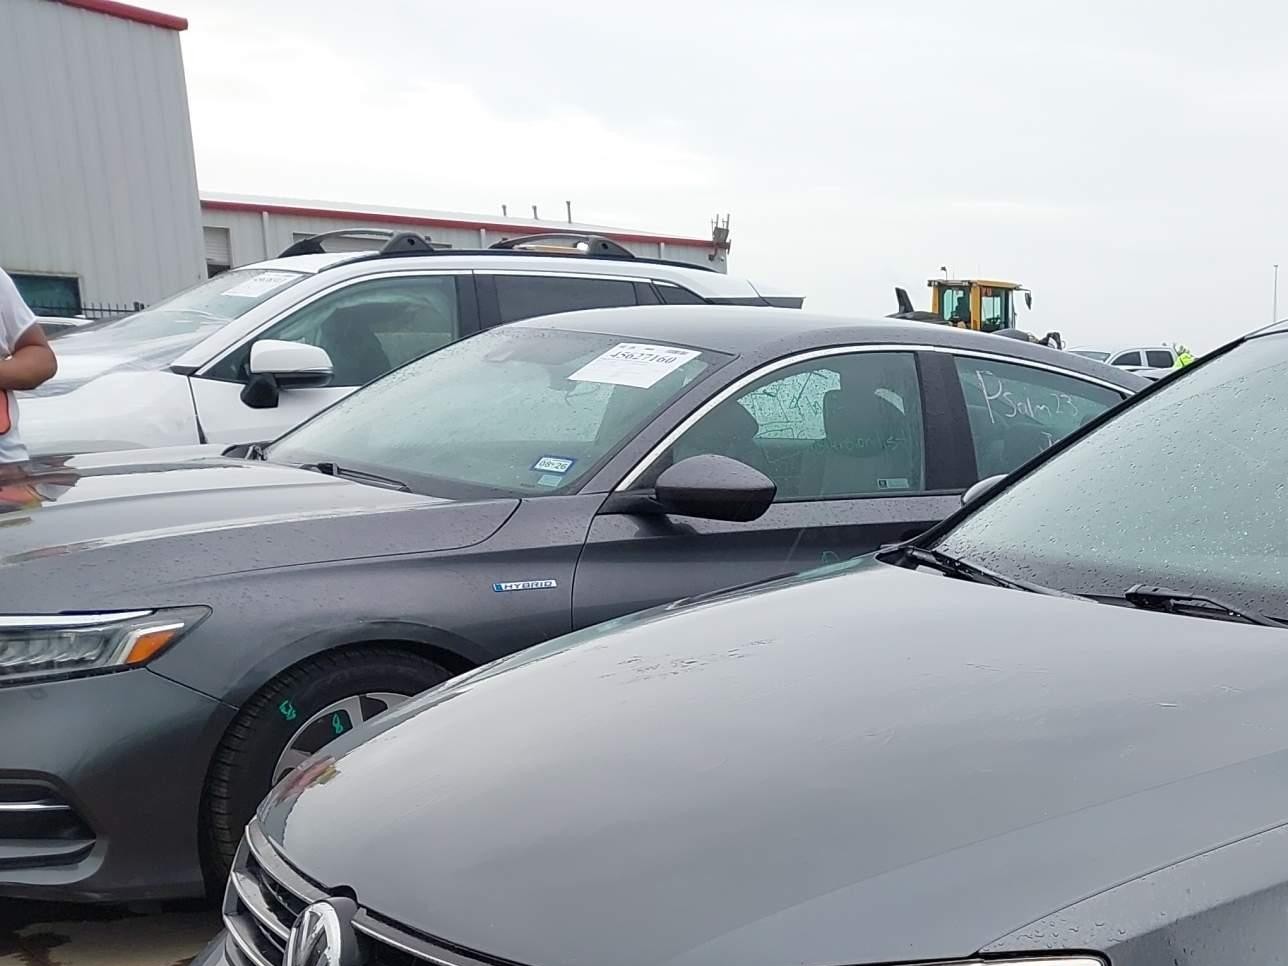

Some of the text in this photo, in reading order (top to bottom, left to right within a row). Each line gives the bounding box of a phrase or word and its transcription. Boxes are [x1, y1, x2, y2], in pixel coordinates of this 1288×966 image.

[610, 351, 678, 364] 45627160
[976, 370, 1078, 424] Psalm 23
[504, 580, 553, 591] HYBRID
